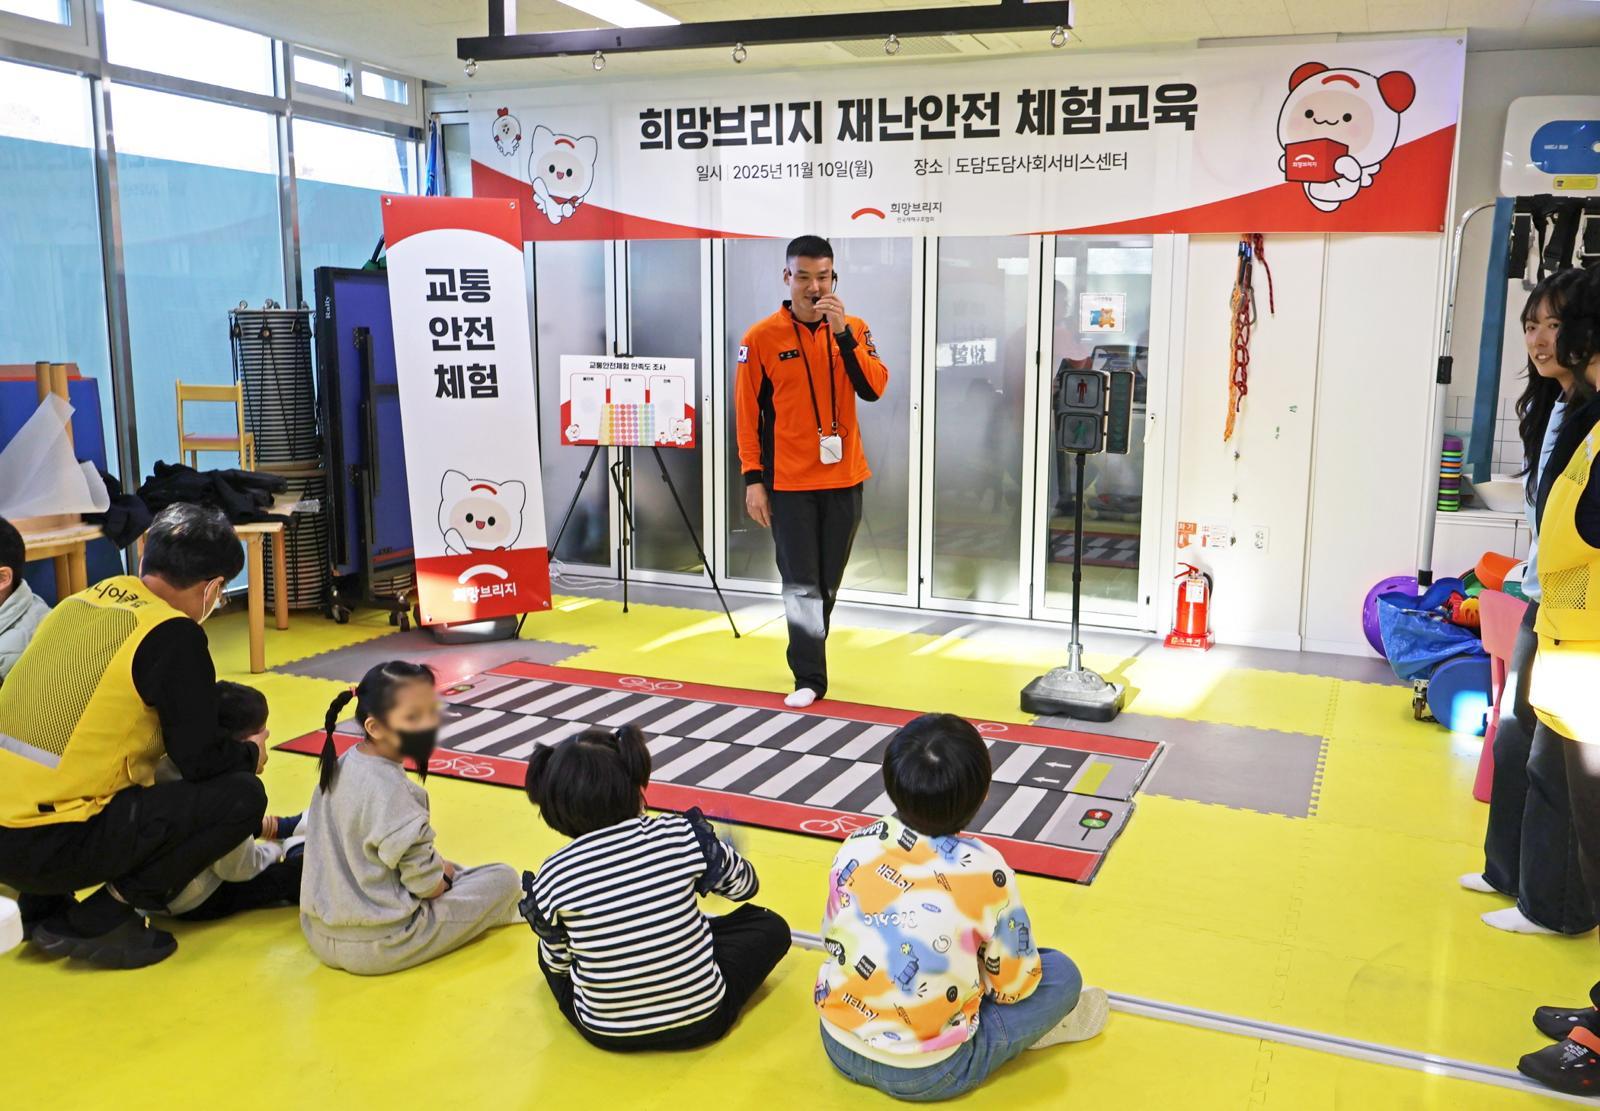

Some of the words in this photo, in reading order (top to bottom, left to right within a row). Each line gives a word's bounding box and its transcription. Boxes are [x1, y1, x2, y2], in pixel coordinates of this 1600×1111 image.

[639, 101, 822, 149] 희망브리지
[837, 93, 1000, 142] 재난안전
[1015, 84, 1198, 135] 체험교육
[696, 164, 722, 182] 일시
[733, 162, 783, 181] 2025년
[787, 161, 814, 180] 11월
[818, 160, 874, 180] 10일(월)
[913, 157, 944, 176] 장소
[954, 151, 1128, 175] 도담도담사회서비스센터
[890, 201, 943, 216] 희망브리지
[425, 268, 491, 303] 교통
[429, 316, 495, 351] 안전
[434, 364, 498, 399] 체험
[453, 582, 517, 604] 망브리지
